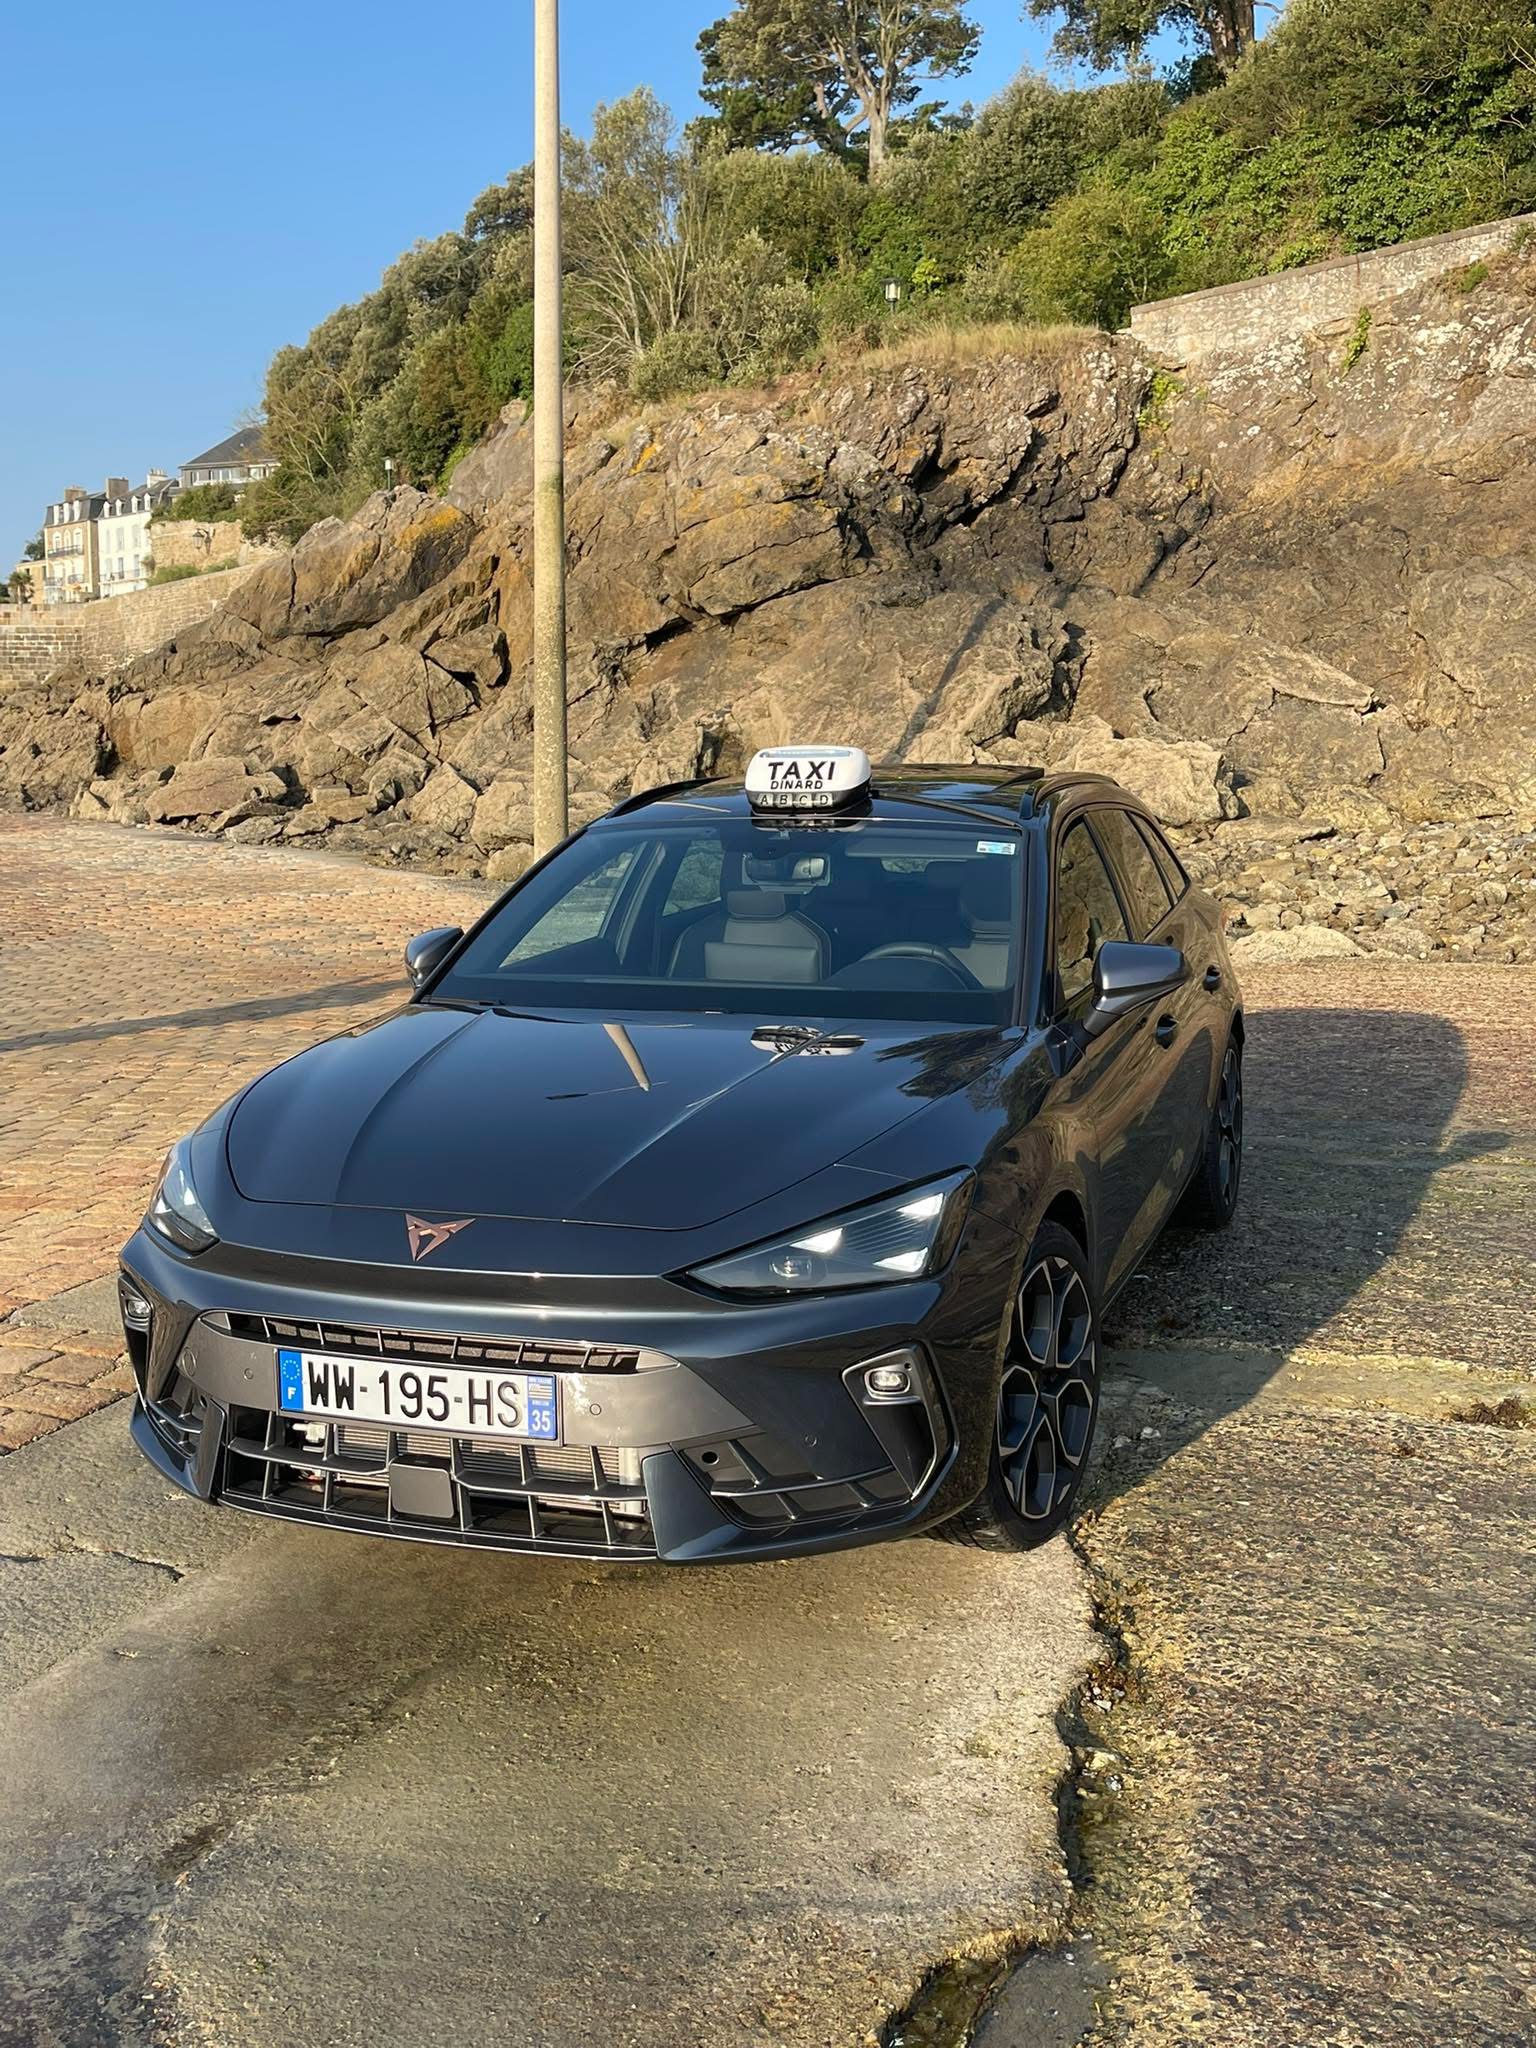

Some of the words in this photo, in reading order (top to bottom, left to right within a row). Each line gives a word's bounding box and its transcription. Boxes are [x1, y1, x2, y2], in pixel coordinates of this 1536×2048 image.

[768, 761, 836, 780] TAXI
[770, 780, 824, 790] DINARD
[287, 1386, 297, 1400] F
[307, 1361, 522, 1428] WW-195-HS
[531, 1409, 551, 1433] 35
